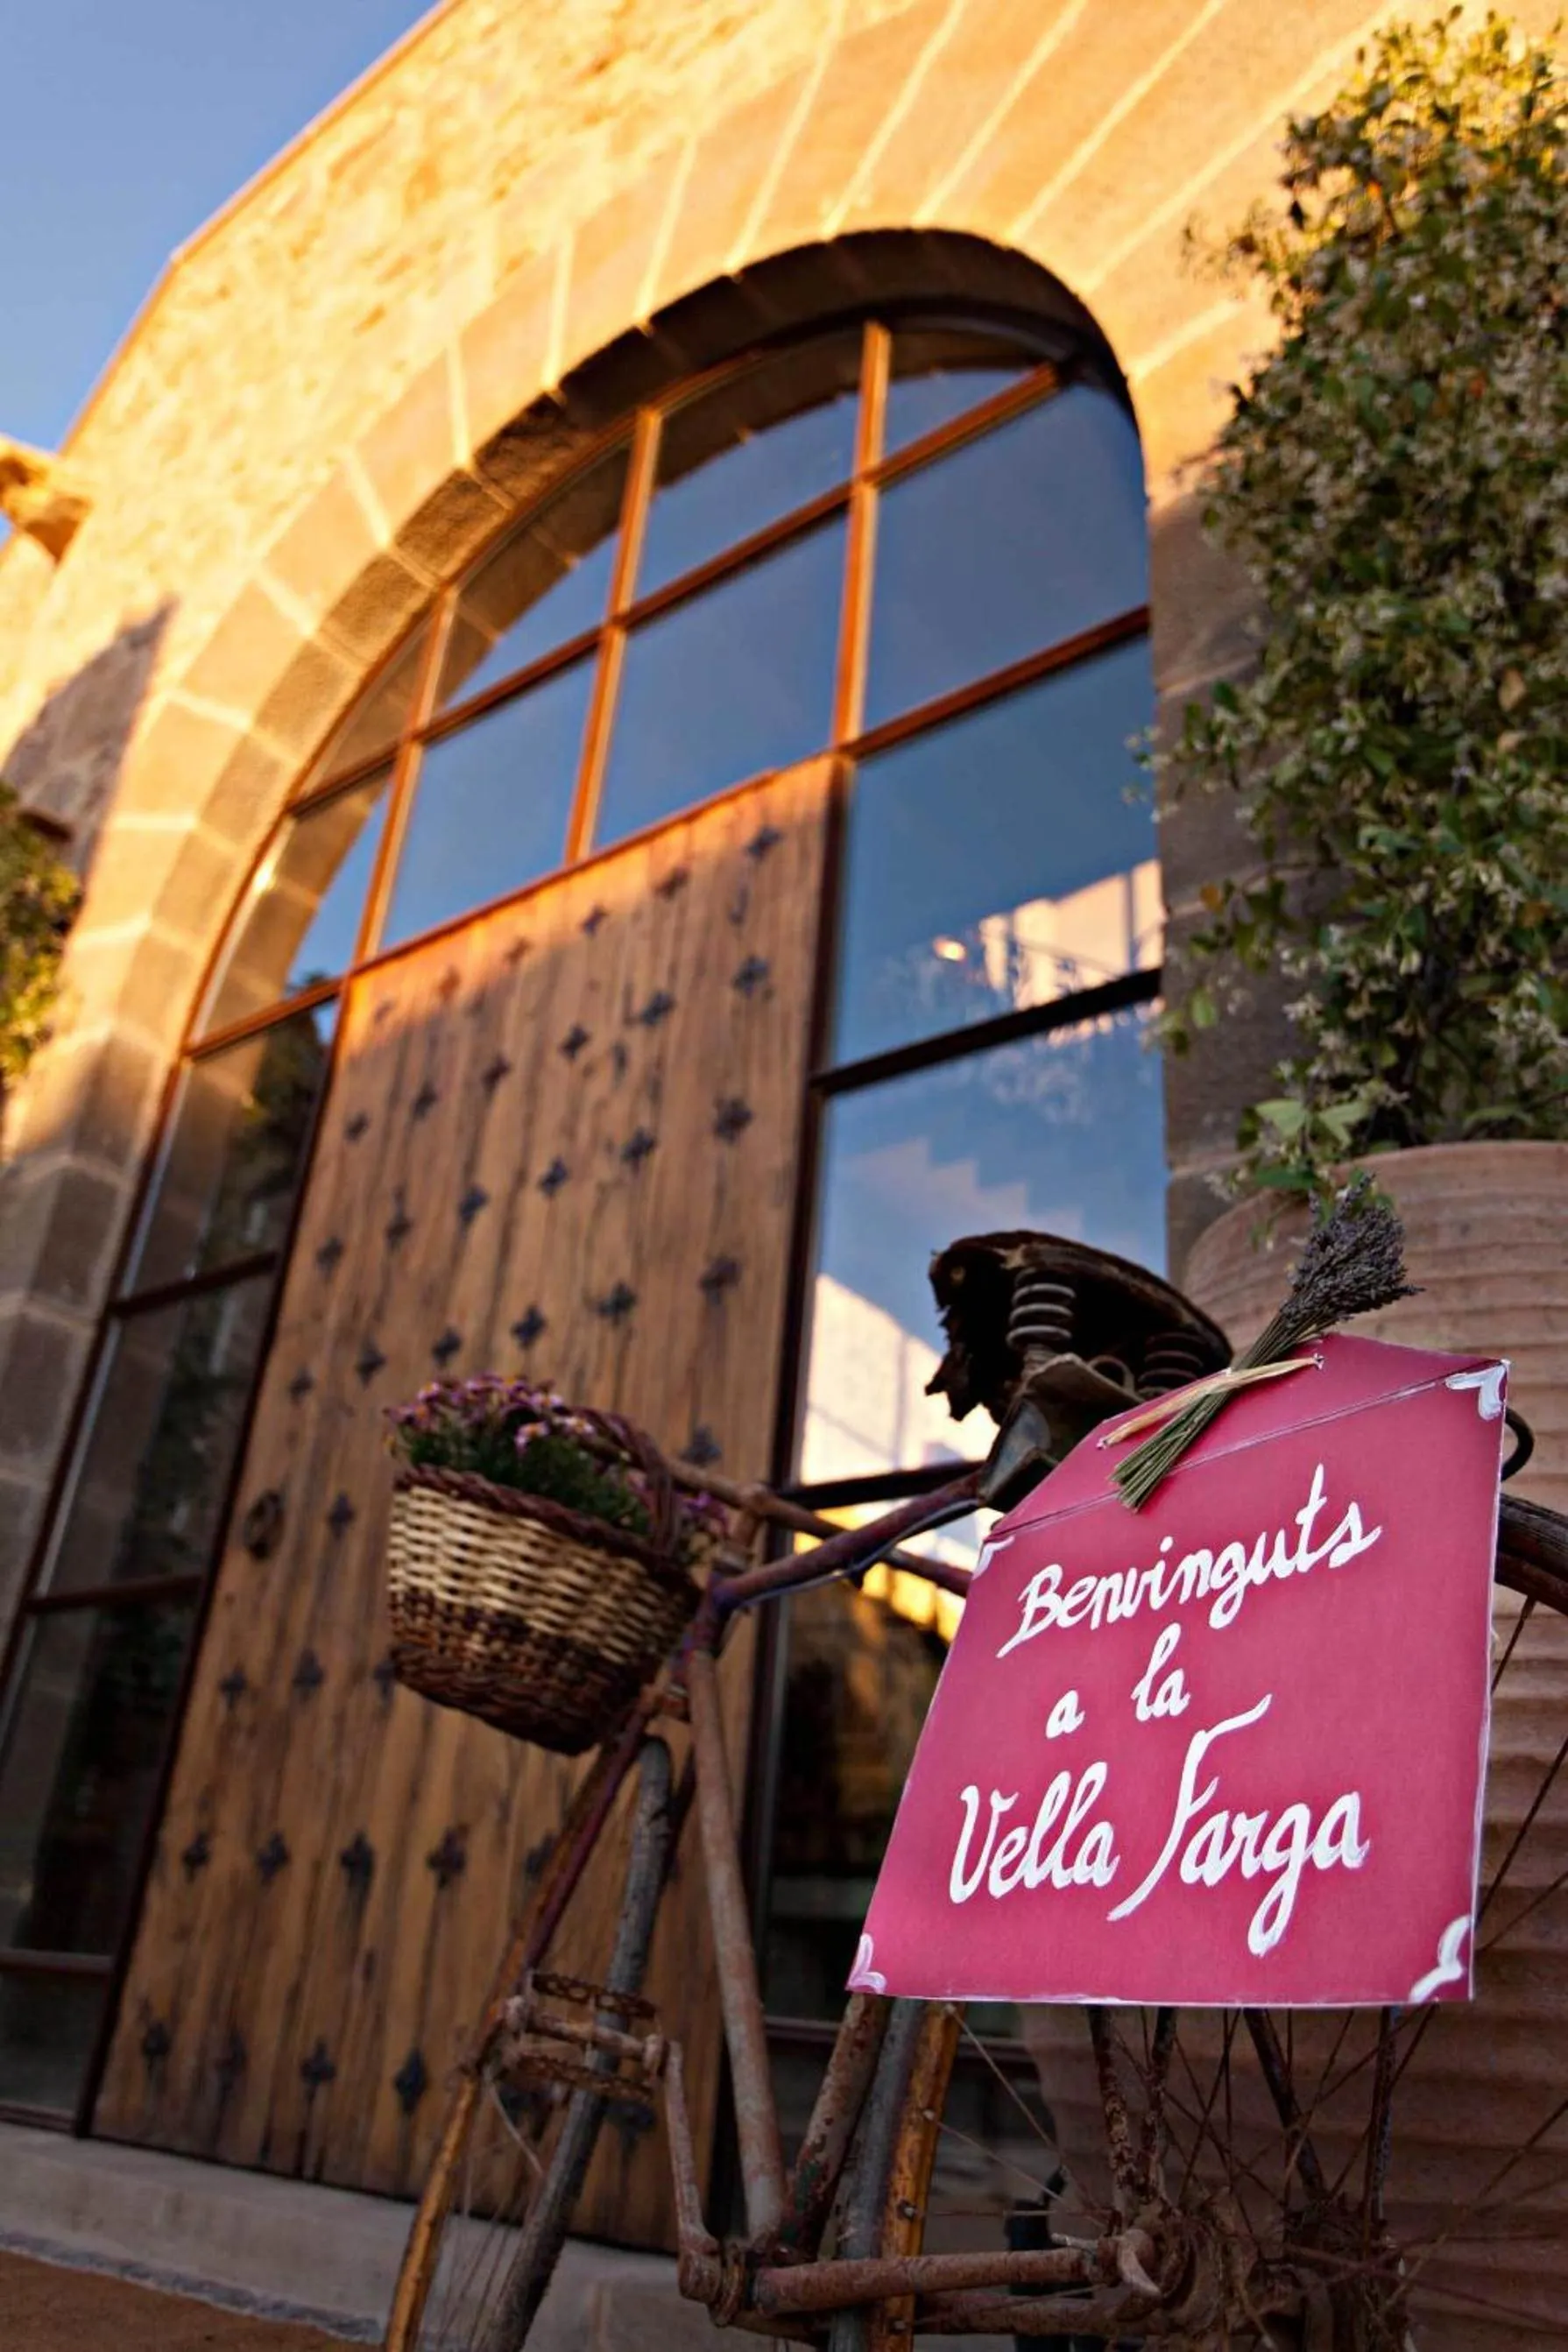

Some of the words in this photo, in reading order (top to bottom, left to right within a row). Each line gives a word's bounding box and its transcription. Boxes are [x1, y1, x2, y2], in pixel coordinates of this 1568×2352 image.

[997, 1464, 1381, 1658] Benvinguts
[1046, 1690, 1085, 1739] a
[1131, 1623, 1190, 1722] la
[950, 1762, 1120, 1903] Vella
[1107, 1693, 1370, 1957] Farga
